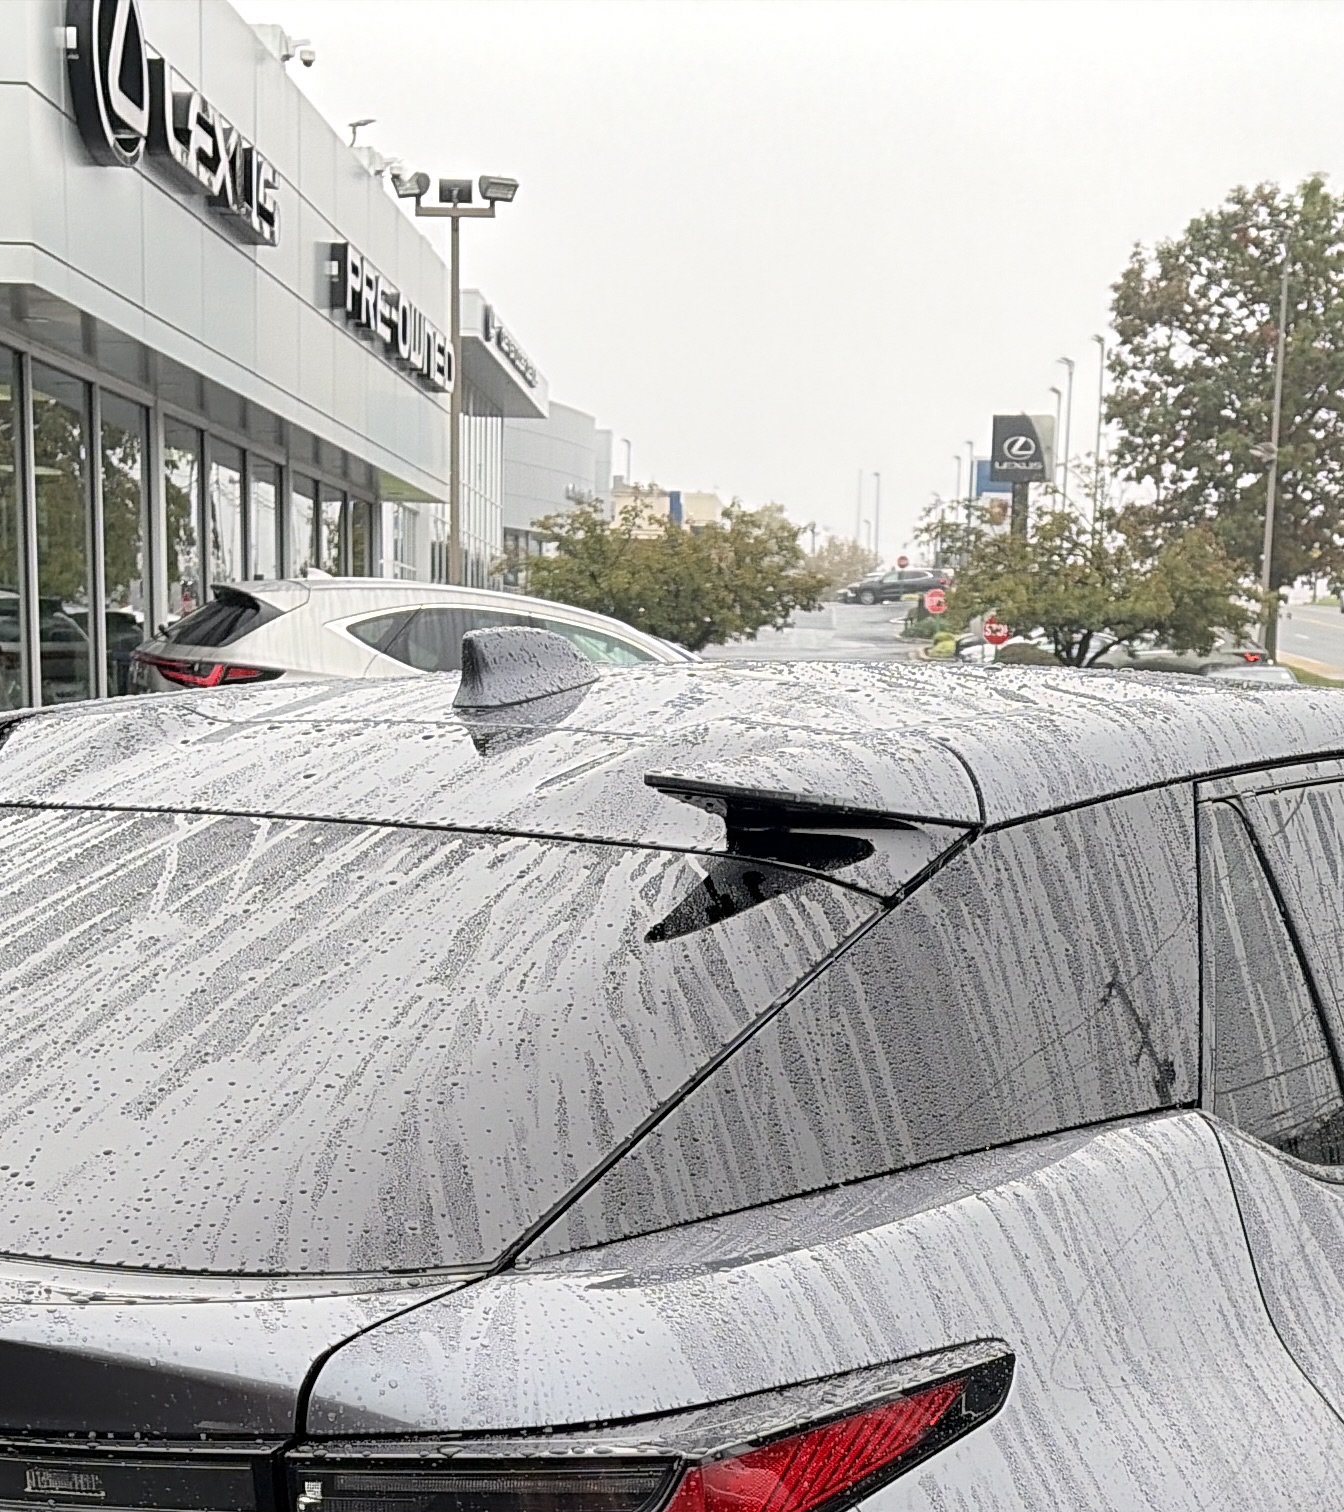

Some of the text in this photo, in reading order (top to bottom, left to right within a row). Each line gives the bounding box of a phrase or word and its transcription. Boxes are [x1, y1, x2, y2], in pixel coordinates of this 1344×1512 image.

[156, 60, 280, 246] LEXUS
[345, 242, 455, 393] PRE-OWNED
[994, 460, 1043, 470] LEXUS
